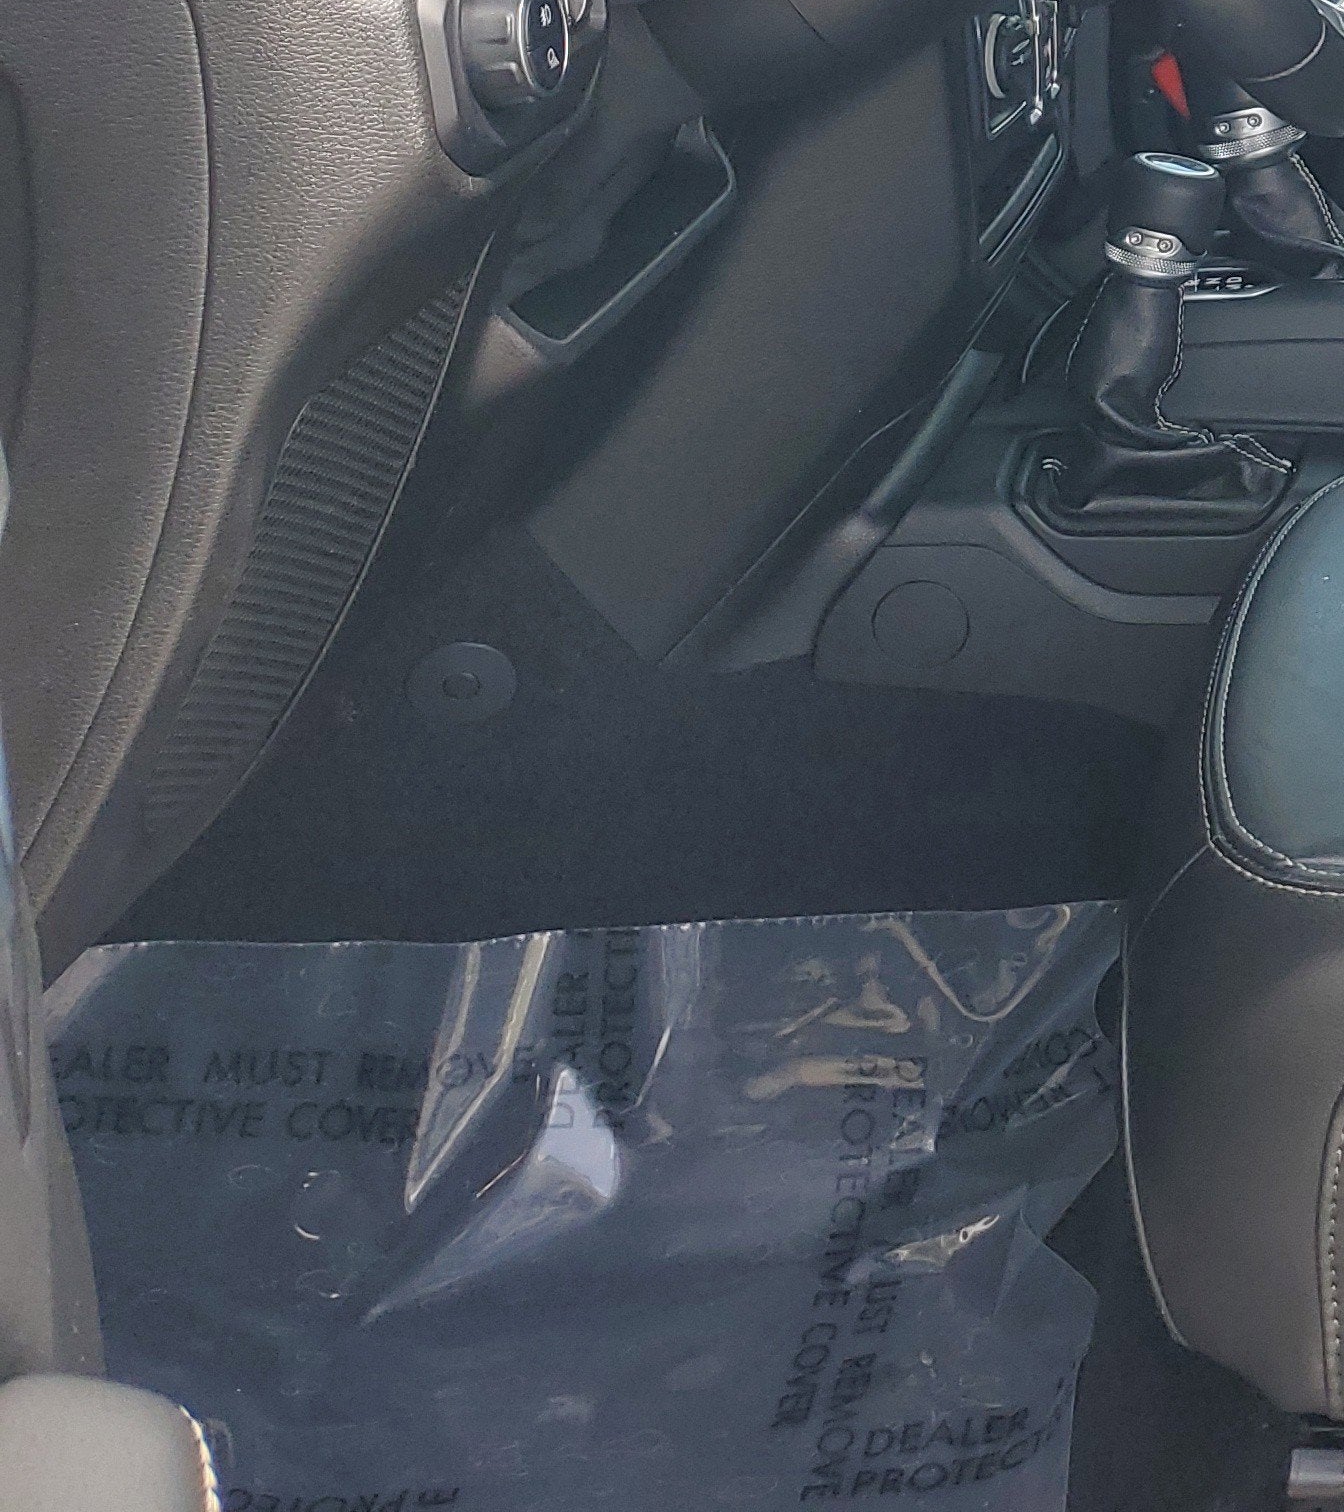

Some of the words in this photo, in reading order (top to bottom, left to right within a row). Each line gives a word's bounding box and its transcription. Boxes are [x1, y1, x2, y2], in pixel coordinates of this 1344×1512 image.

[50, 1044, 170, 1084] EALER
[202, 1048, 335, 1088] MUST
[57, 1094, 268, 1139] OTECTIVE
[285, 1099, 420, 1144] COVER
[812, 1056, 882, 1310] PROTECTIVE
[770, 1320, 838, 1431] COVER
[798, 1352, 877, 1504] REMOVE
[863, 1406, 1030, 1458] DEALER
